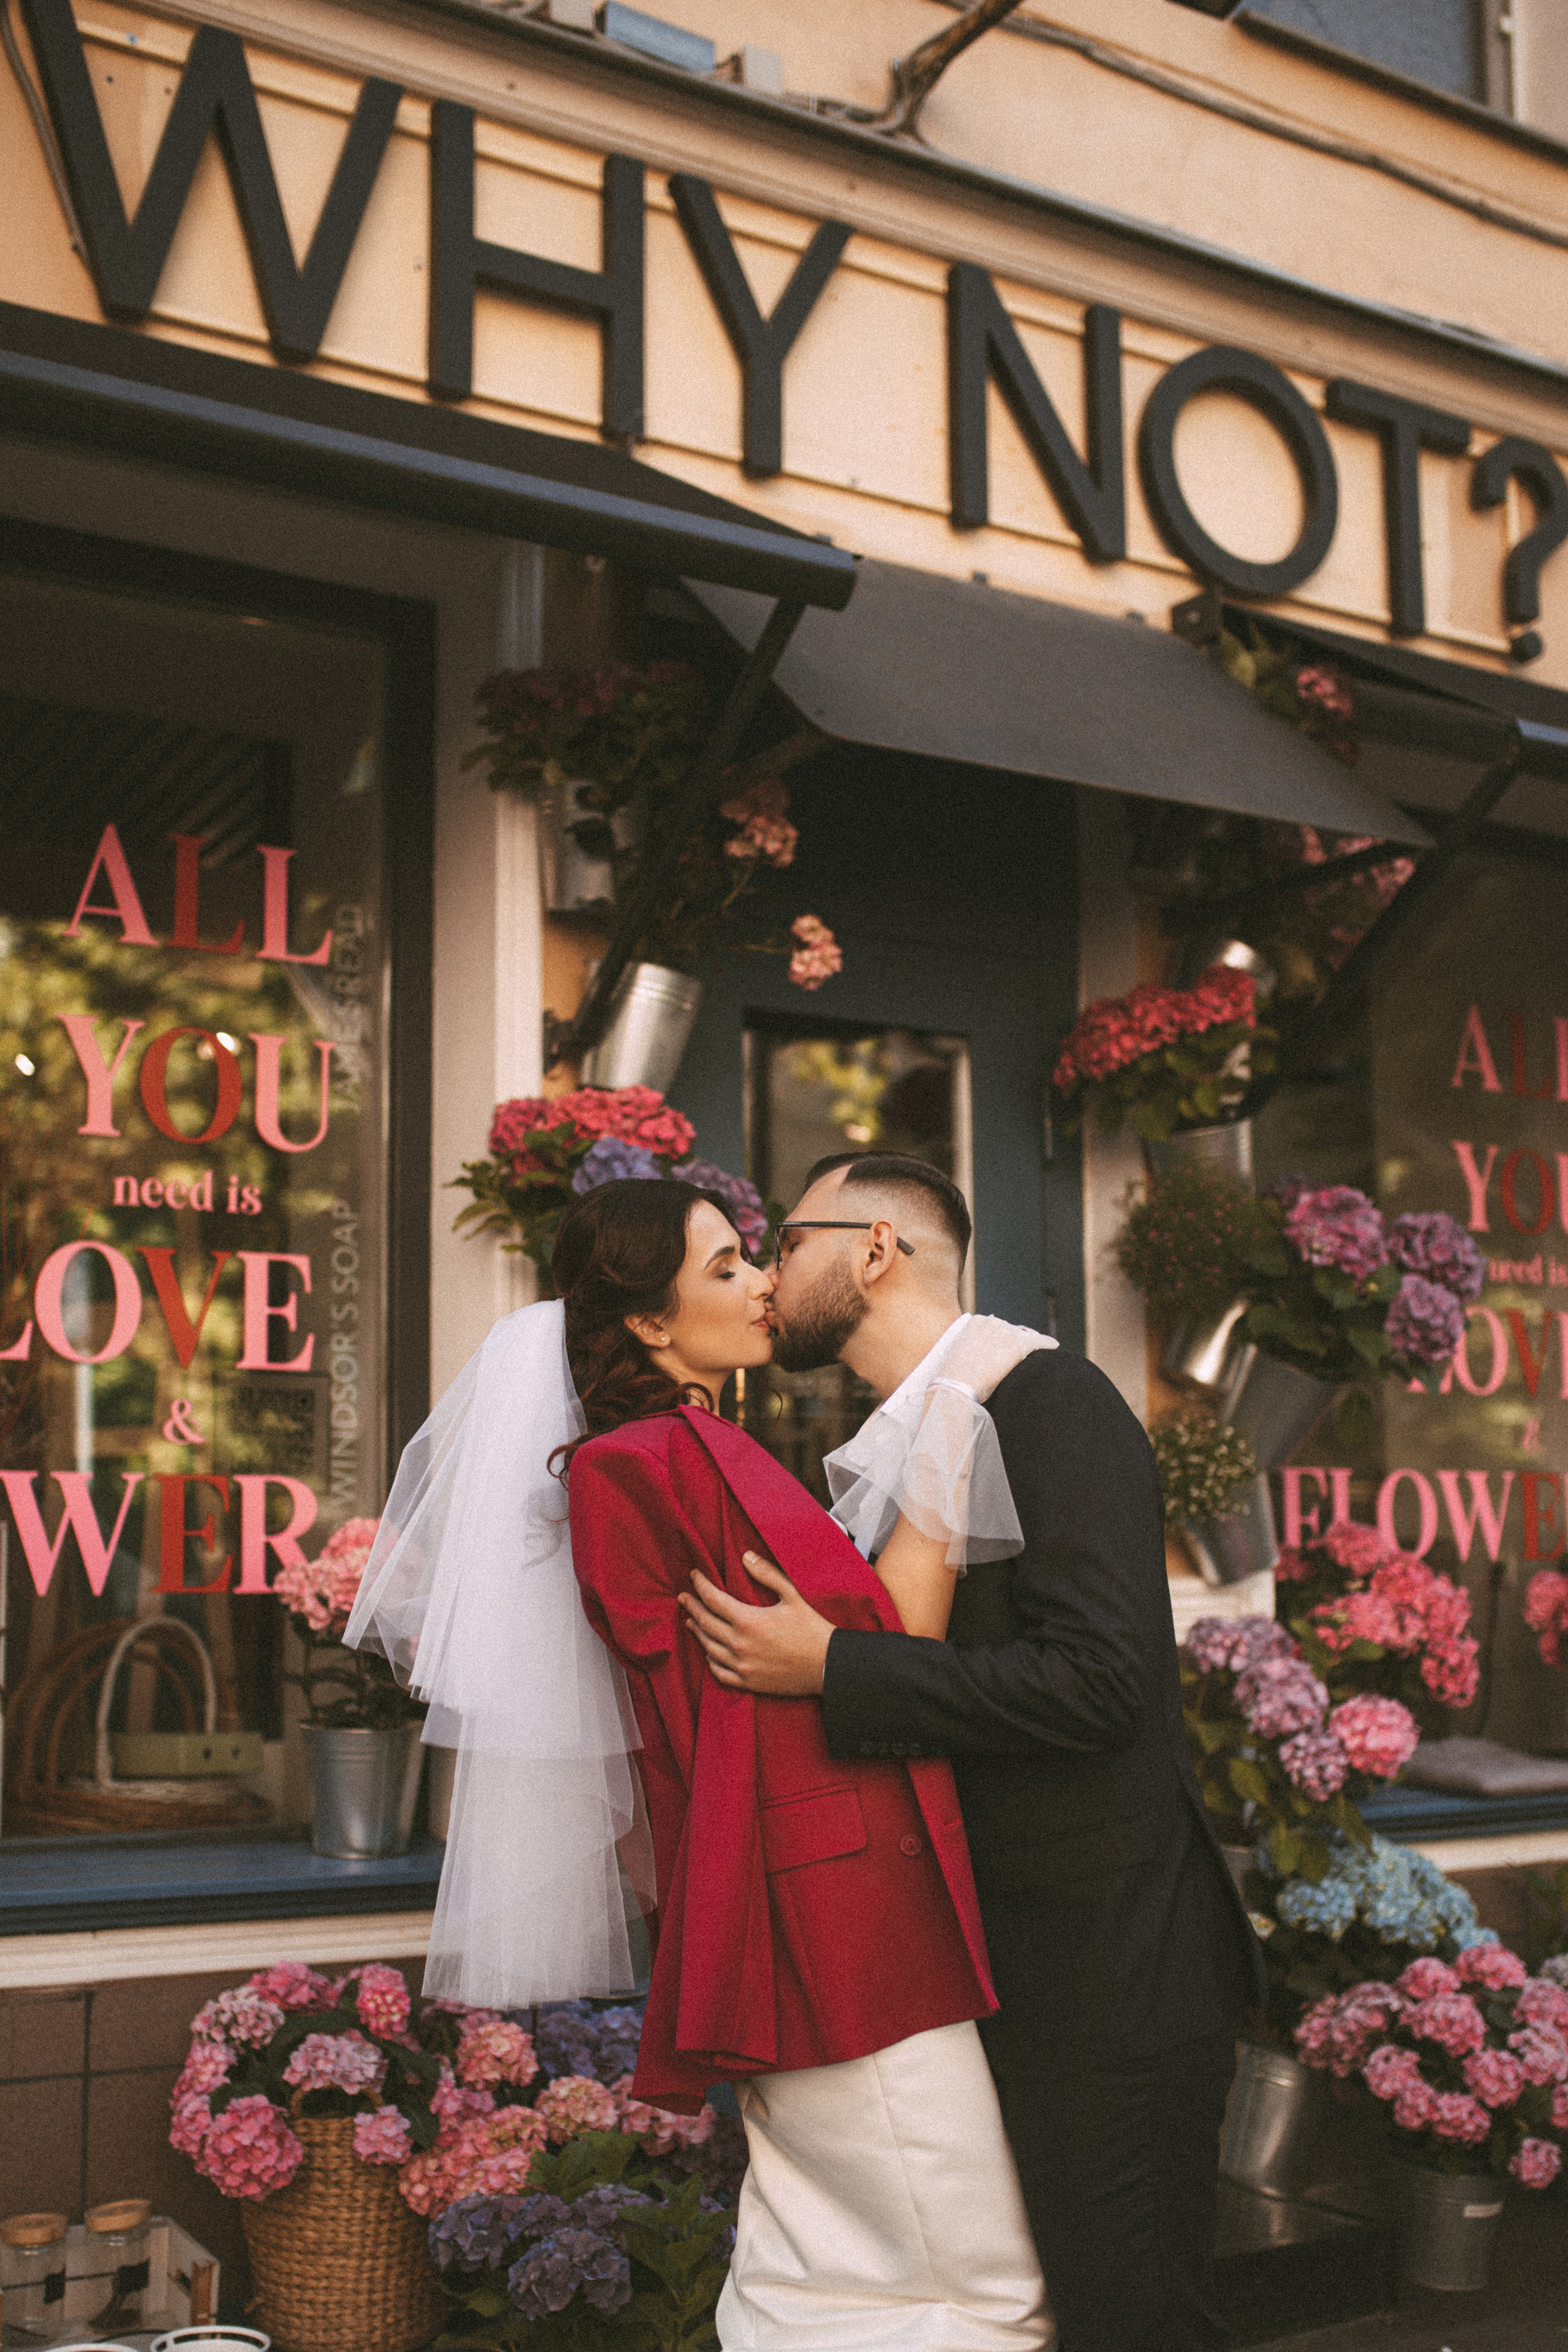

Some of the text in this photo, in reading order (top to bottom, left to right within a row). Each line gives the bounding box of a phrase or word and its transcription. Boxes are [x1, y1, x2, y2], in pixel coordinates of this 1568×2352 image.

[20, 0, 1568, 664] WHY NOT?
[62, 823, 333, 965] ALL
[55, 1012, 336, 1153] YOU
[113, 1170, 262, 1215] need is
[163, 1398, 206, 1444] &
[331, 1199, 359, 1507] WINDSOR'S SOAP
[1281, 1466, 1568, 1562] FLOWE
